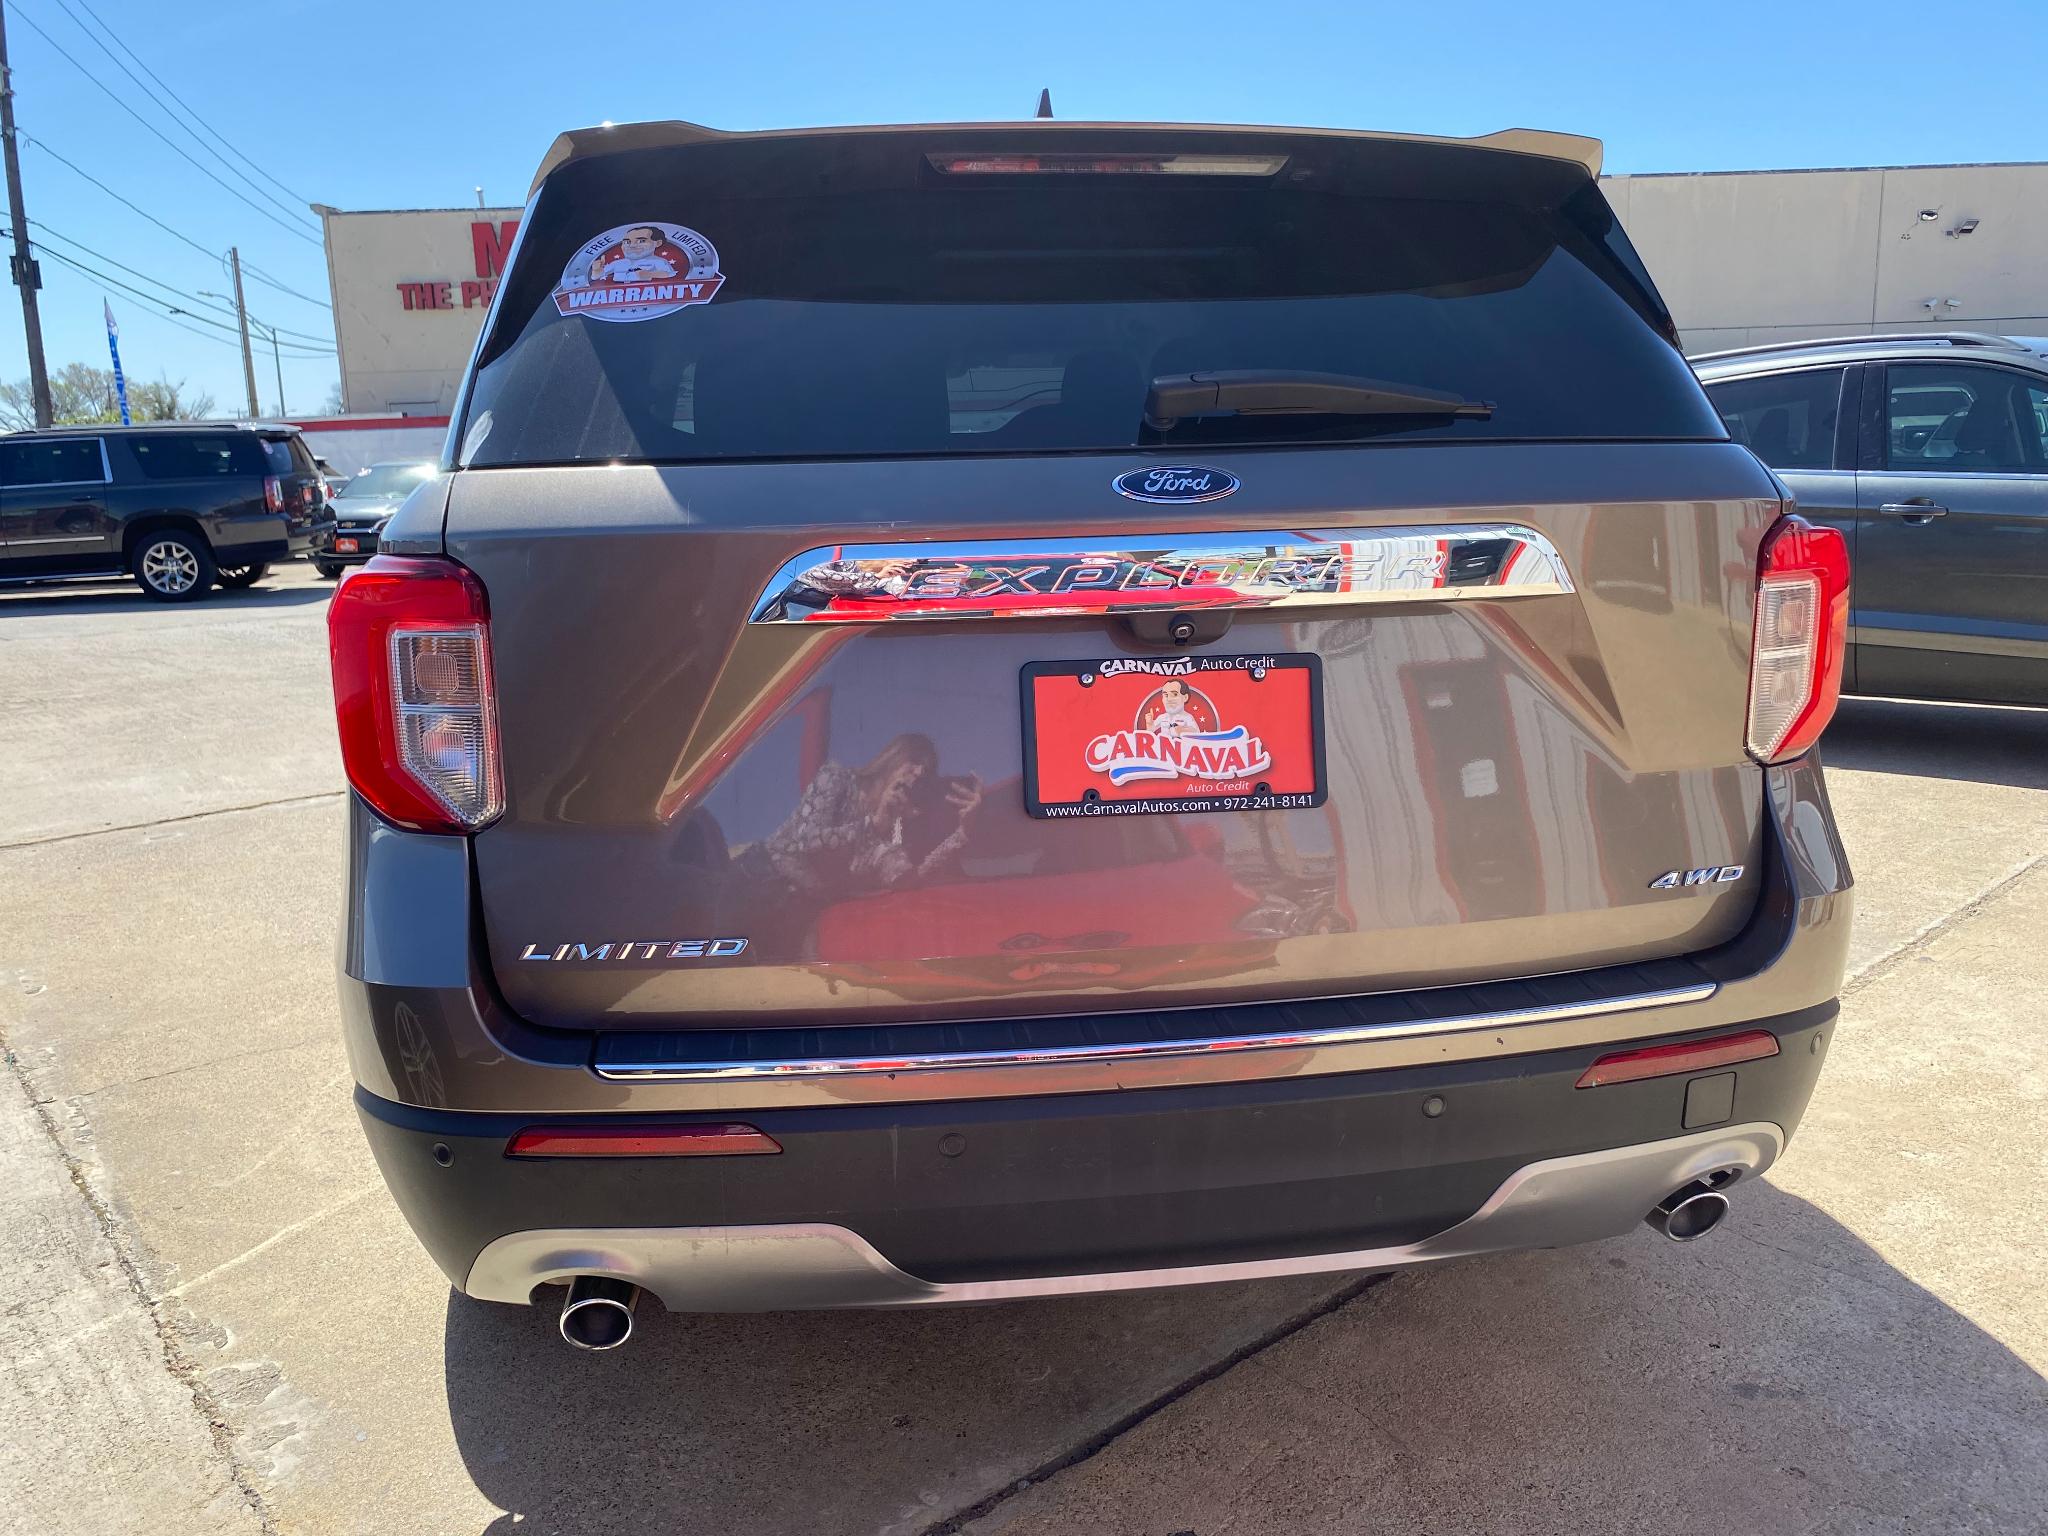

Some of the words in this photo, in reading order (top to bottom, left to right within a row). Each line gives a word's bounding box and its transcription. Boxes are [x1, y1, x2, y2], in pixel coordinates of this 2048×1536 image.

[585, 235, 614, 256] FREE
[671, 231, 707, 256] LIMITED
[397, 282, 453, 310] THE
[569, 283, 704, 308] WARRANTY
[1144, 469, 1211, 492] Ford
[899, 550, 1446, 600] EXPLORER
[1099, 656, 1197, 678] CARNAVAL
[1200, 658, 1233, 671] Auto
[1235, 656, 1276, 670] Credit
[1086, 730, 1272, 778] CARNAVAL
[1186, 782, 1213, 793] Auto
[1215, 781, 1250, 793] Credit
[1046, 800, 1211, 817] www.CarnavalAutos.com
[1224, 795, 1313, 811] 972-241-8141
[1648, 865, 1745, 889] 4WD
[518, 938, 749, 961] LIMITED
